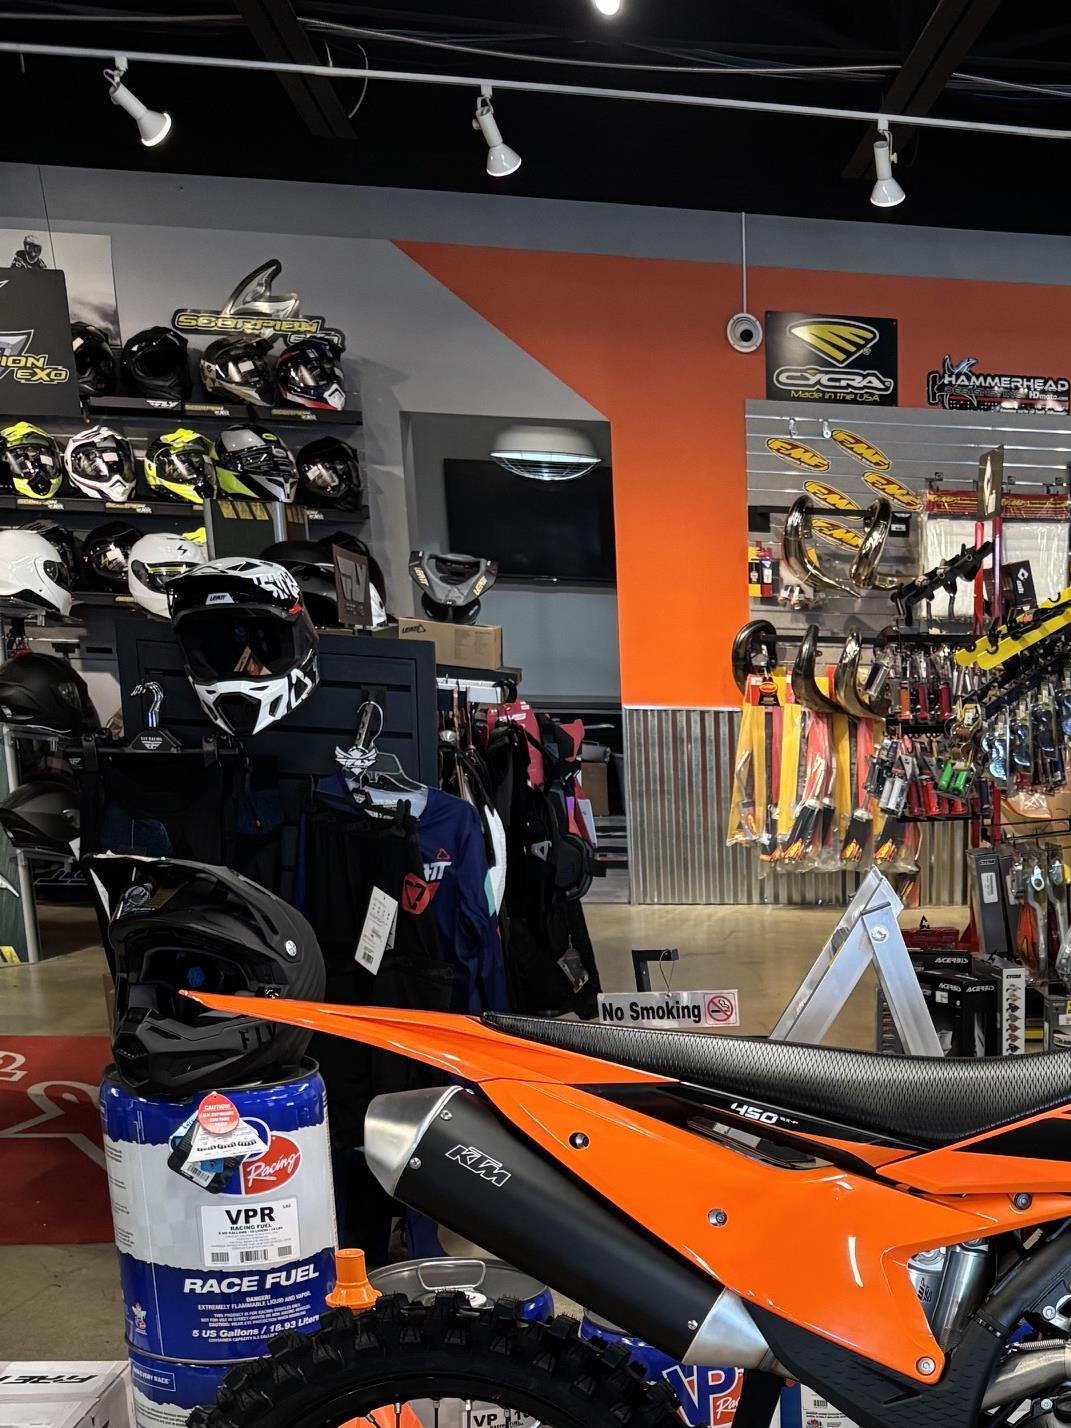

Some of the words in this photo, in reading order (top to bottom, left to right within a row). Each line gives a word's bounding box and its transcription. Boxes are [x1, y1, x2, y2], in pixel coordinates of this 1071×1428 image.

[176, 314, 320, 333] SCORPION
[0, 356, 45, 367] ION
[16, 369, 67, 381] EXO
[779, 372, 885, 389] CYCRA
[944, 374, 1069, 391] HAMMERHEAD
[790, 390, 822, 399] Made
[825, 391, 833, 400] in
[836, 391, 854, 401] the
[857, 394, 880, 402] USA
[768, 438, 830, 471] FMF
[832, 430, 890, 470] FMF
[863, 472, 921, 510] FMF
[602, 1003, 624, 1021] No
[630, 1001, 701, 1023] Smoking
[239, 1022, 277, 1051] FLY
[731, 1102, 778, 1125] 450
[247, 1152, 297, 1188] Racing
[446, 1145, 511, 1187] KTM
[225, 1206, 275, 1226] VPR
[183, 1275, 260, 1294] RACE
[265, 1264, 320, 1289] FUEL
[231, 1300, 265, 1309] FLAMMABLE
[267, 1297, 284, 1306] LIQUID
[246, 1294, 271, 1302] DANGER!
[192, 1329, 200, 1337] 5
[202, 1329, 217, 1338] US
[219, 1328, 259, 1338] Gallons
[269, 1320, 297, 1333] 18.93
[298, 1315, 320, 1327] Liters
[473, 1413, 498, 1428] VP
